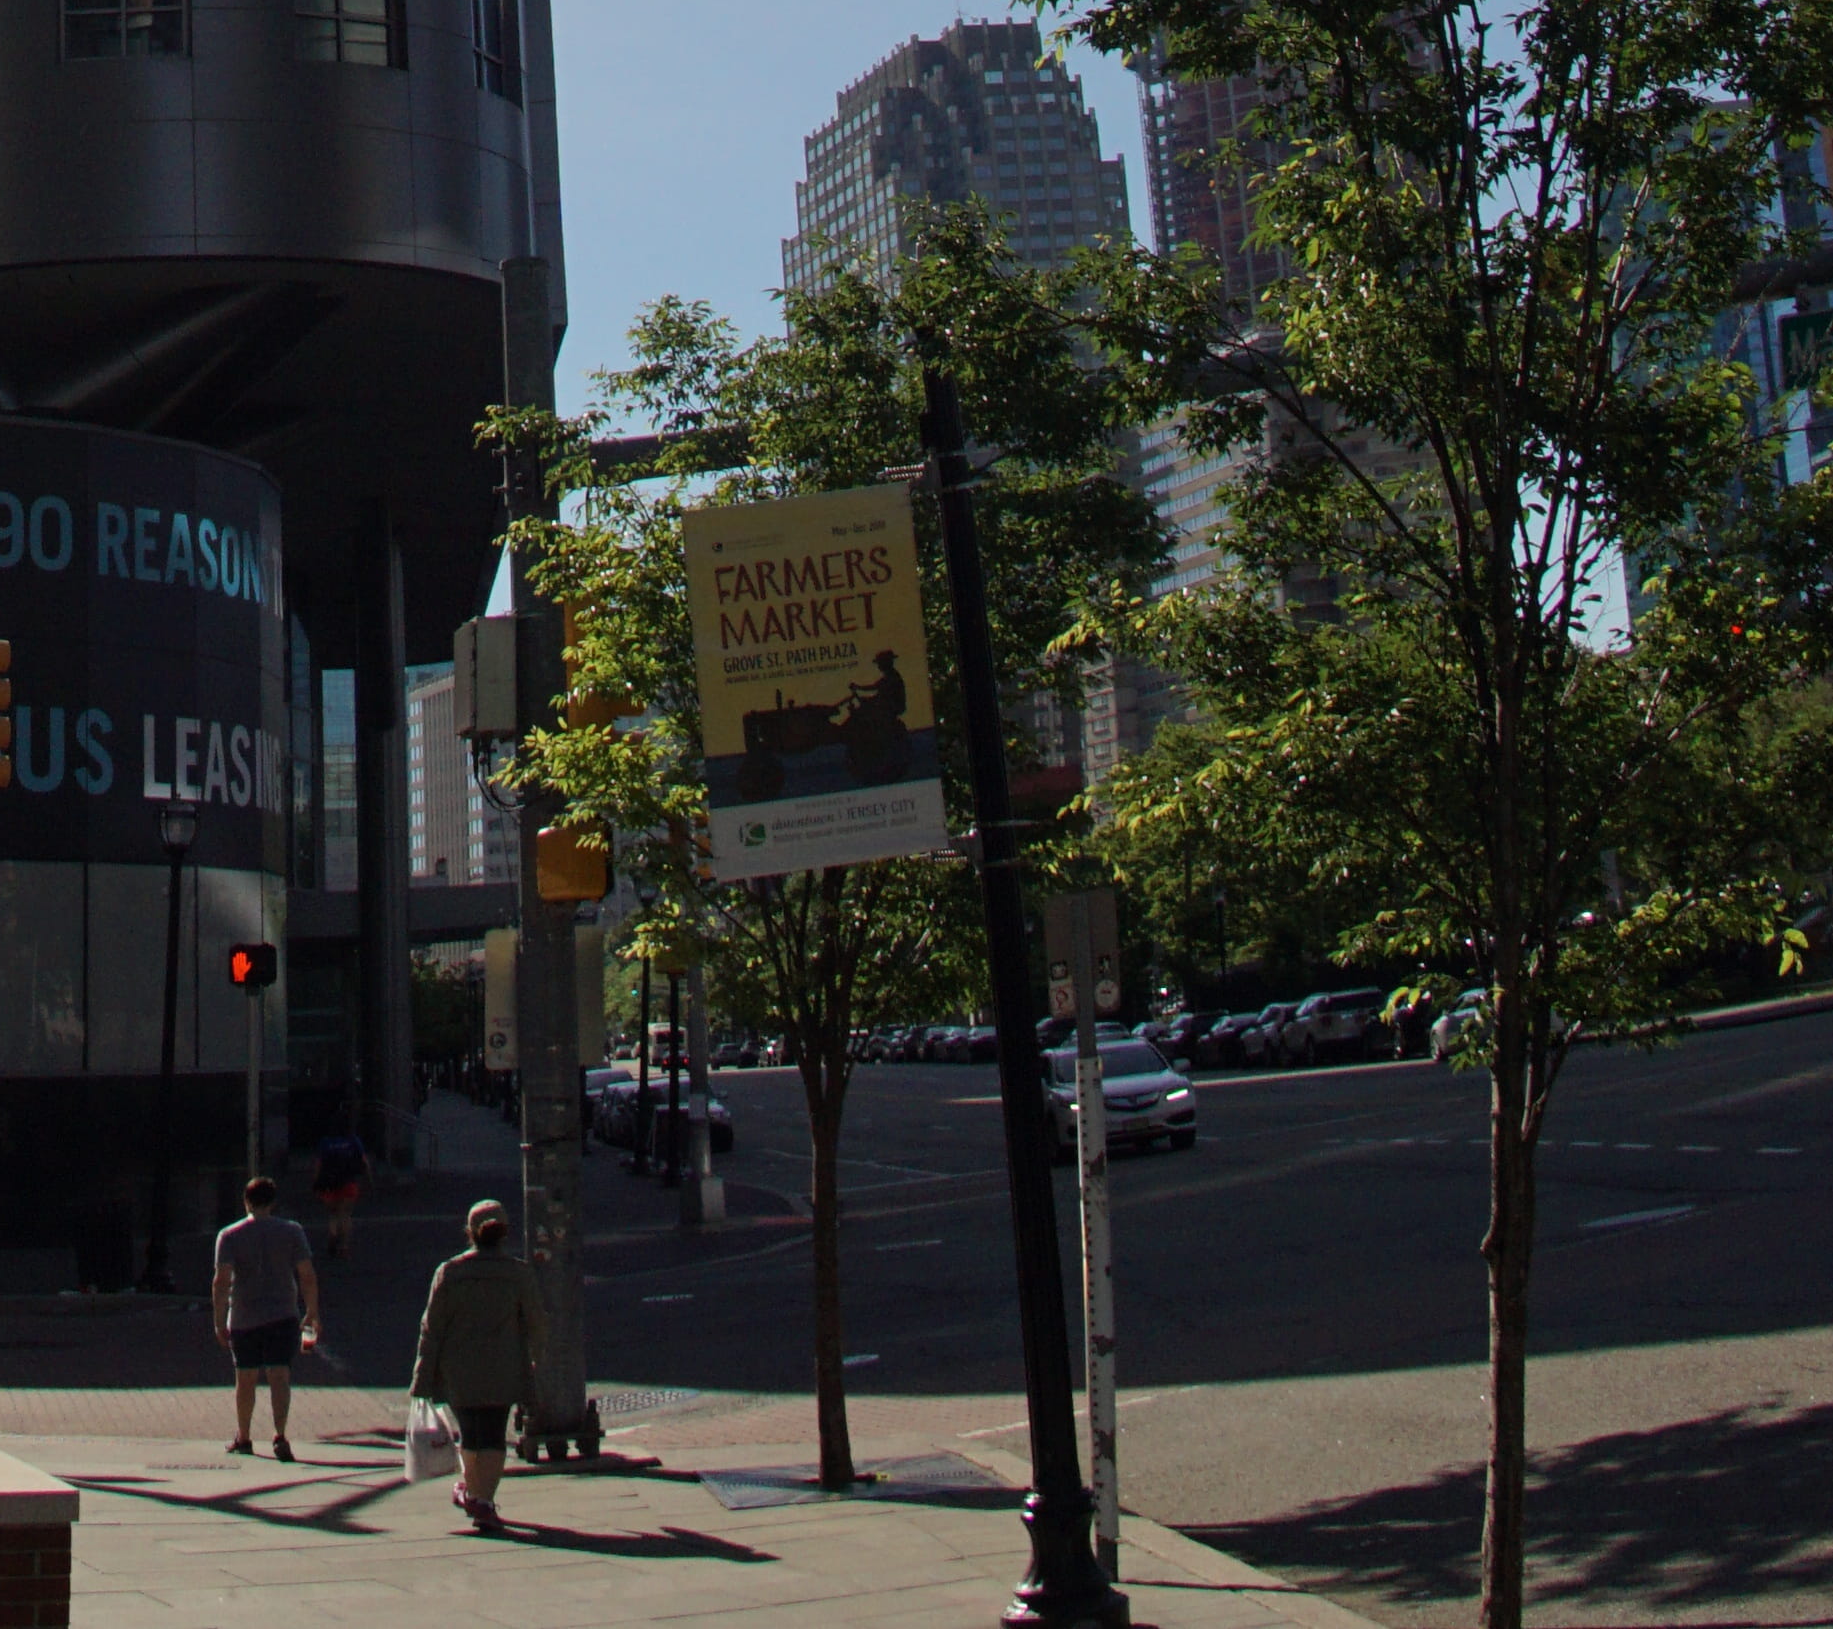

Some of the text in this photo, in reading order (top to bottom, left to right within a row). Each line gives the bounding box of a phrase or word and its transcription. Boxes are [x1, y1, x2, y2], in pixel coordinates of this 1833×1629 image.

[714, 546, 892, 605] FARMERS
[720, 592, 877, 650] MARKET
[723, 654, 763, 674] GROVE
[766, 652, 783, 668] ST.
[786, 647, 817, 664] PATH
[819, 643, 857, 661] PLAZA
